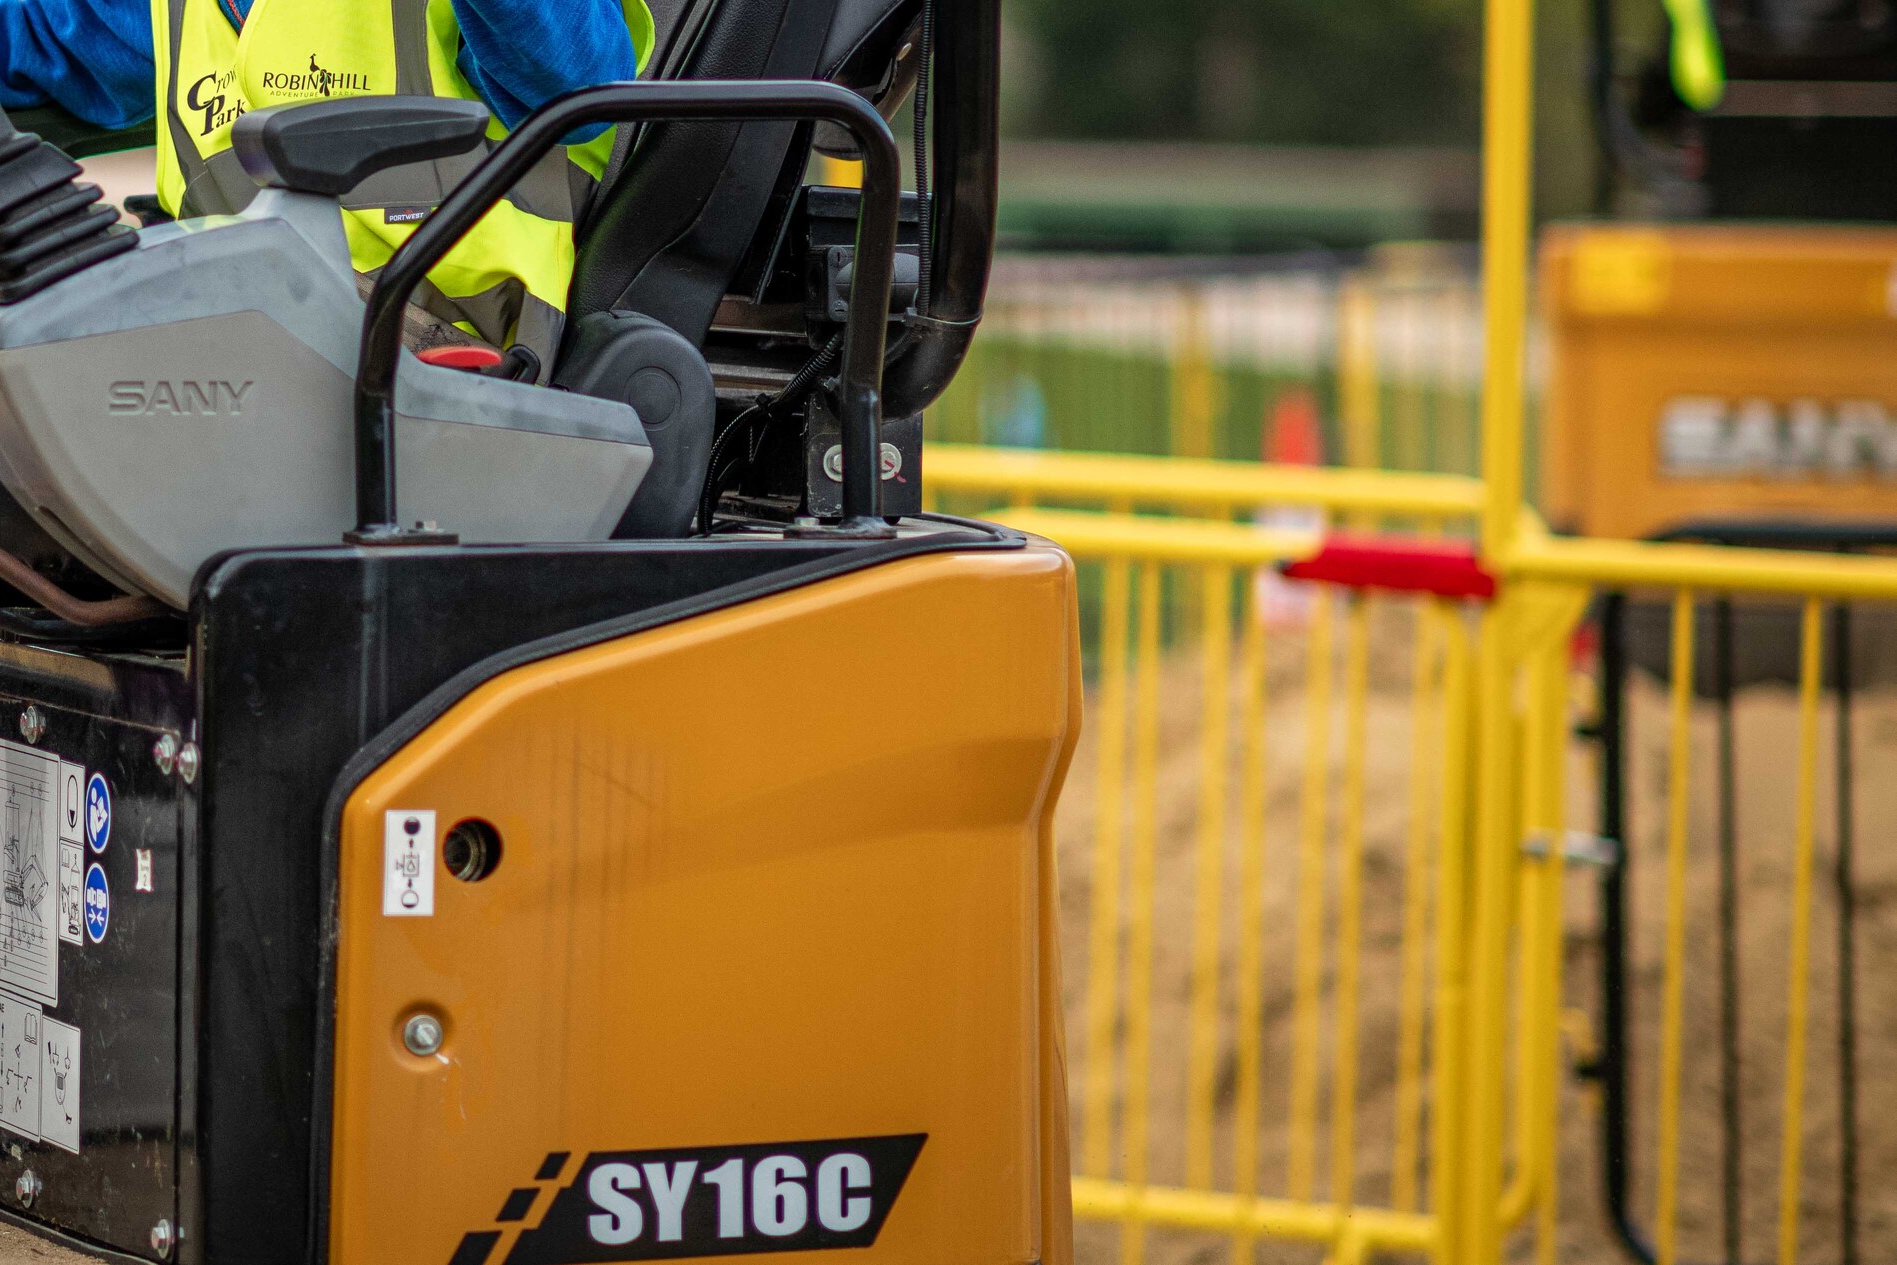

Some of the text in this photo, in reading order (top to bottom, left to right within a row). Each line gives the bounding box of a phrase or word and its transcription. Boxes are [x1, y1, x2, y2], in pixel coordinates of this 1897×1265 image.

[263, 72, 372, 91] ROBIN HILL
[270, 90, 319, 98] ADVENTURE
[200, 94, 247, 137] Park
[389, 212, 425, 222] PORTWEST
[109, 380, 254, 416] SANY
[587, 1152, 873, 1246] SY16C
